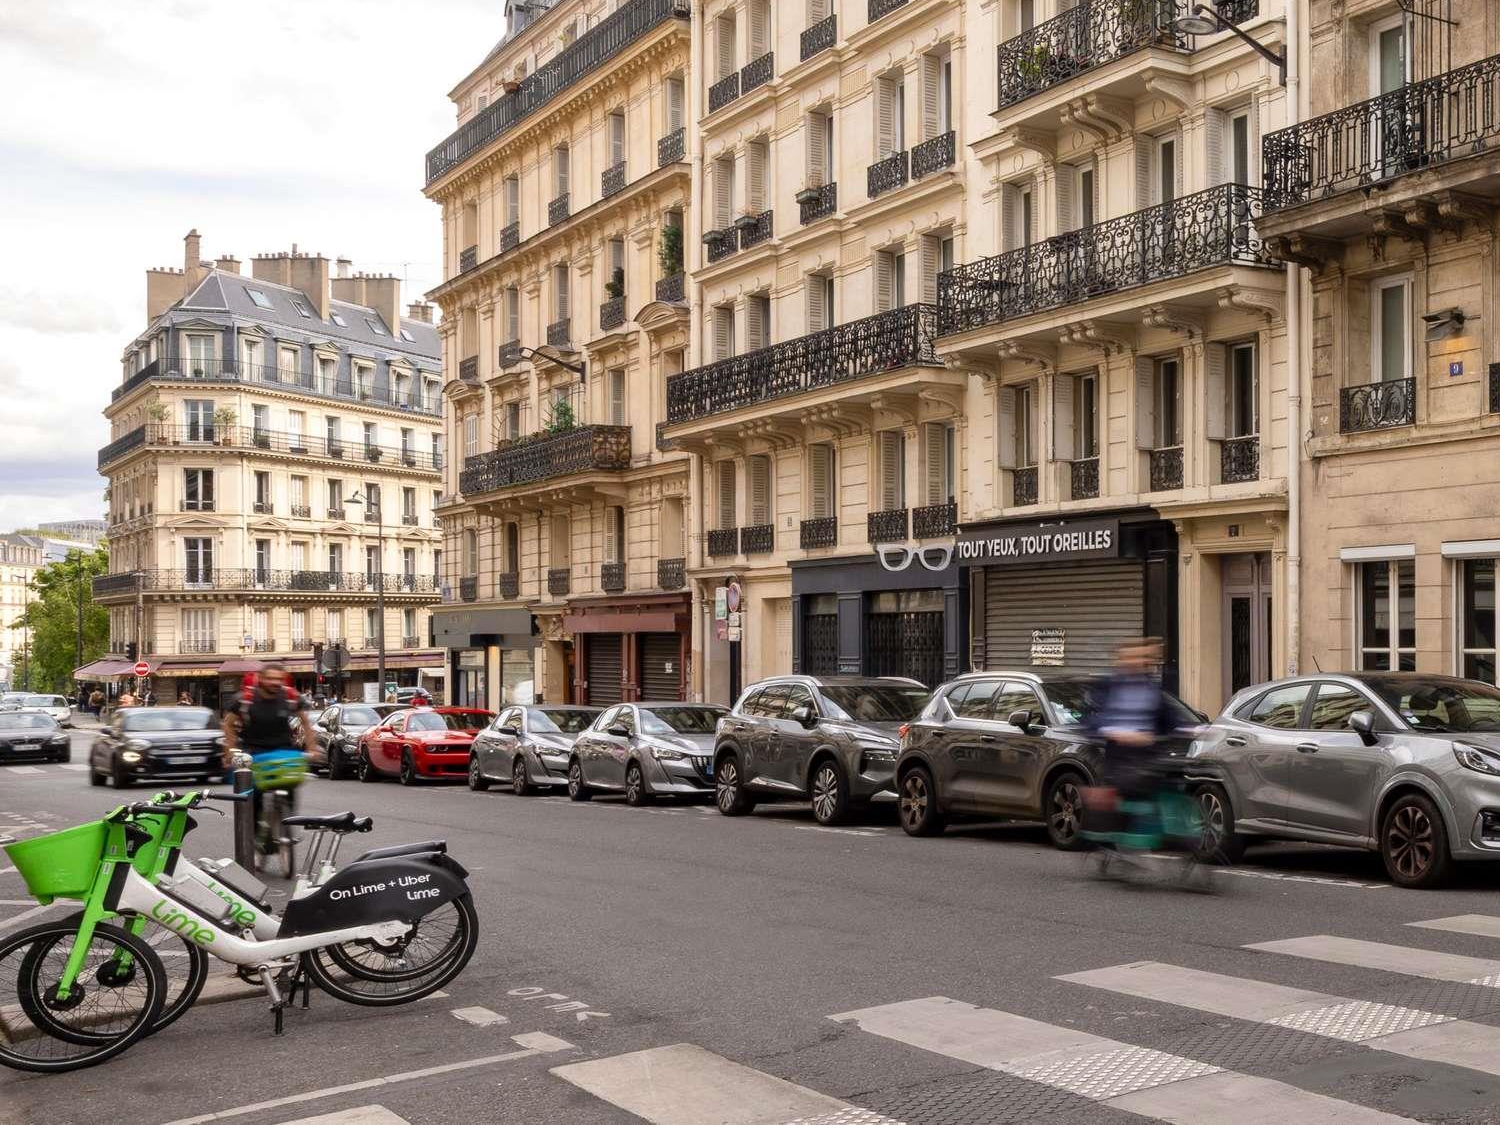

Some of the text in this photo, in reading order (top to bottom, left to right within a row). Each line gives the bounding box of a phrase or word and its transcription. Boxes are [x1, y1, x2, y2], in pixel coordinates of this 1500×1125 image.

[957, 529, 1112, 559] TOUT YEUX, TOUT OREILLES
[329, 890, 352, 900] On
[353, 882, 386, 896] Lime
[399, 874, 432, 887] Uber
[406, 887, 441, 901] Lime
[152, 899, 216, 946] Lime
